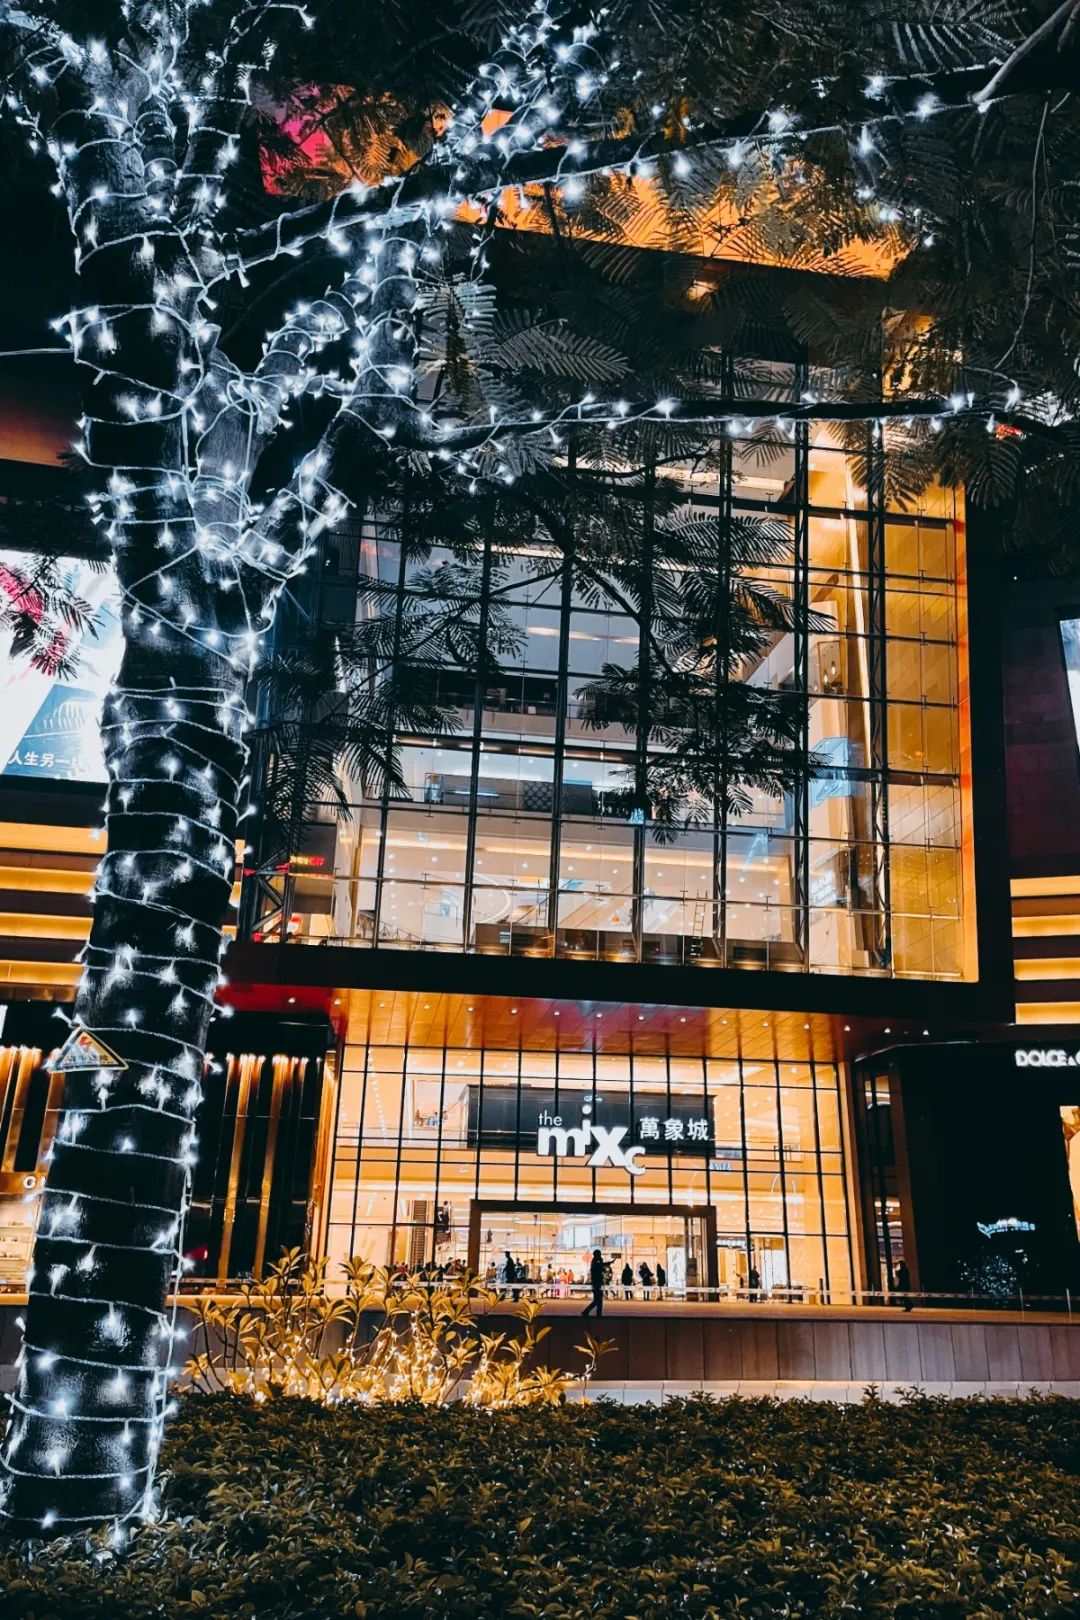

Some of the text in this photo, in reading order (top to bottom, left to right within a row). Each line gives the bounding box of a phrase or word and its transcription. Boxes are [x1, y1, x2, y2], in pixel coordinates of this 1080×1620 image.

[538, 1109, 563, 1127] the
[639, 1116, 709, 1141] 萬象城
